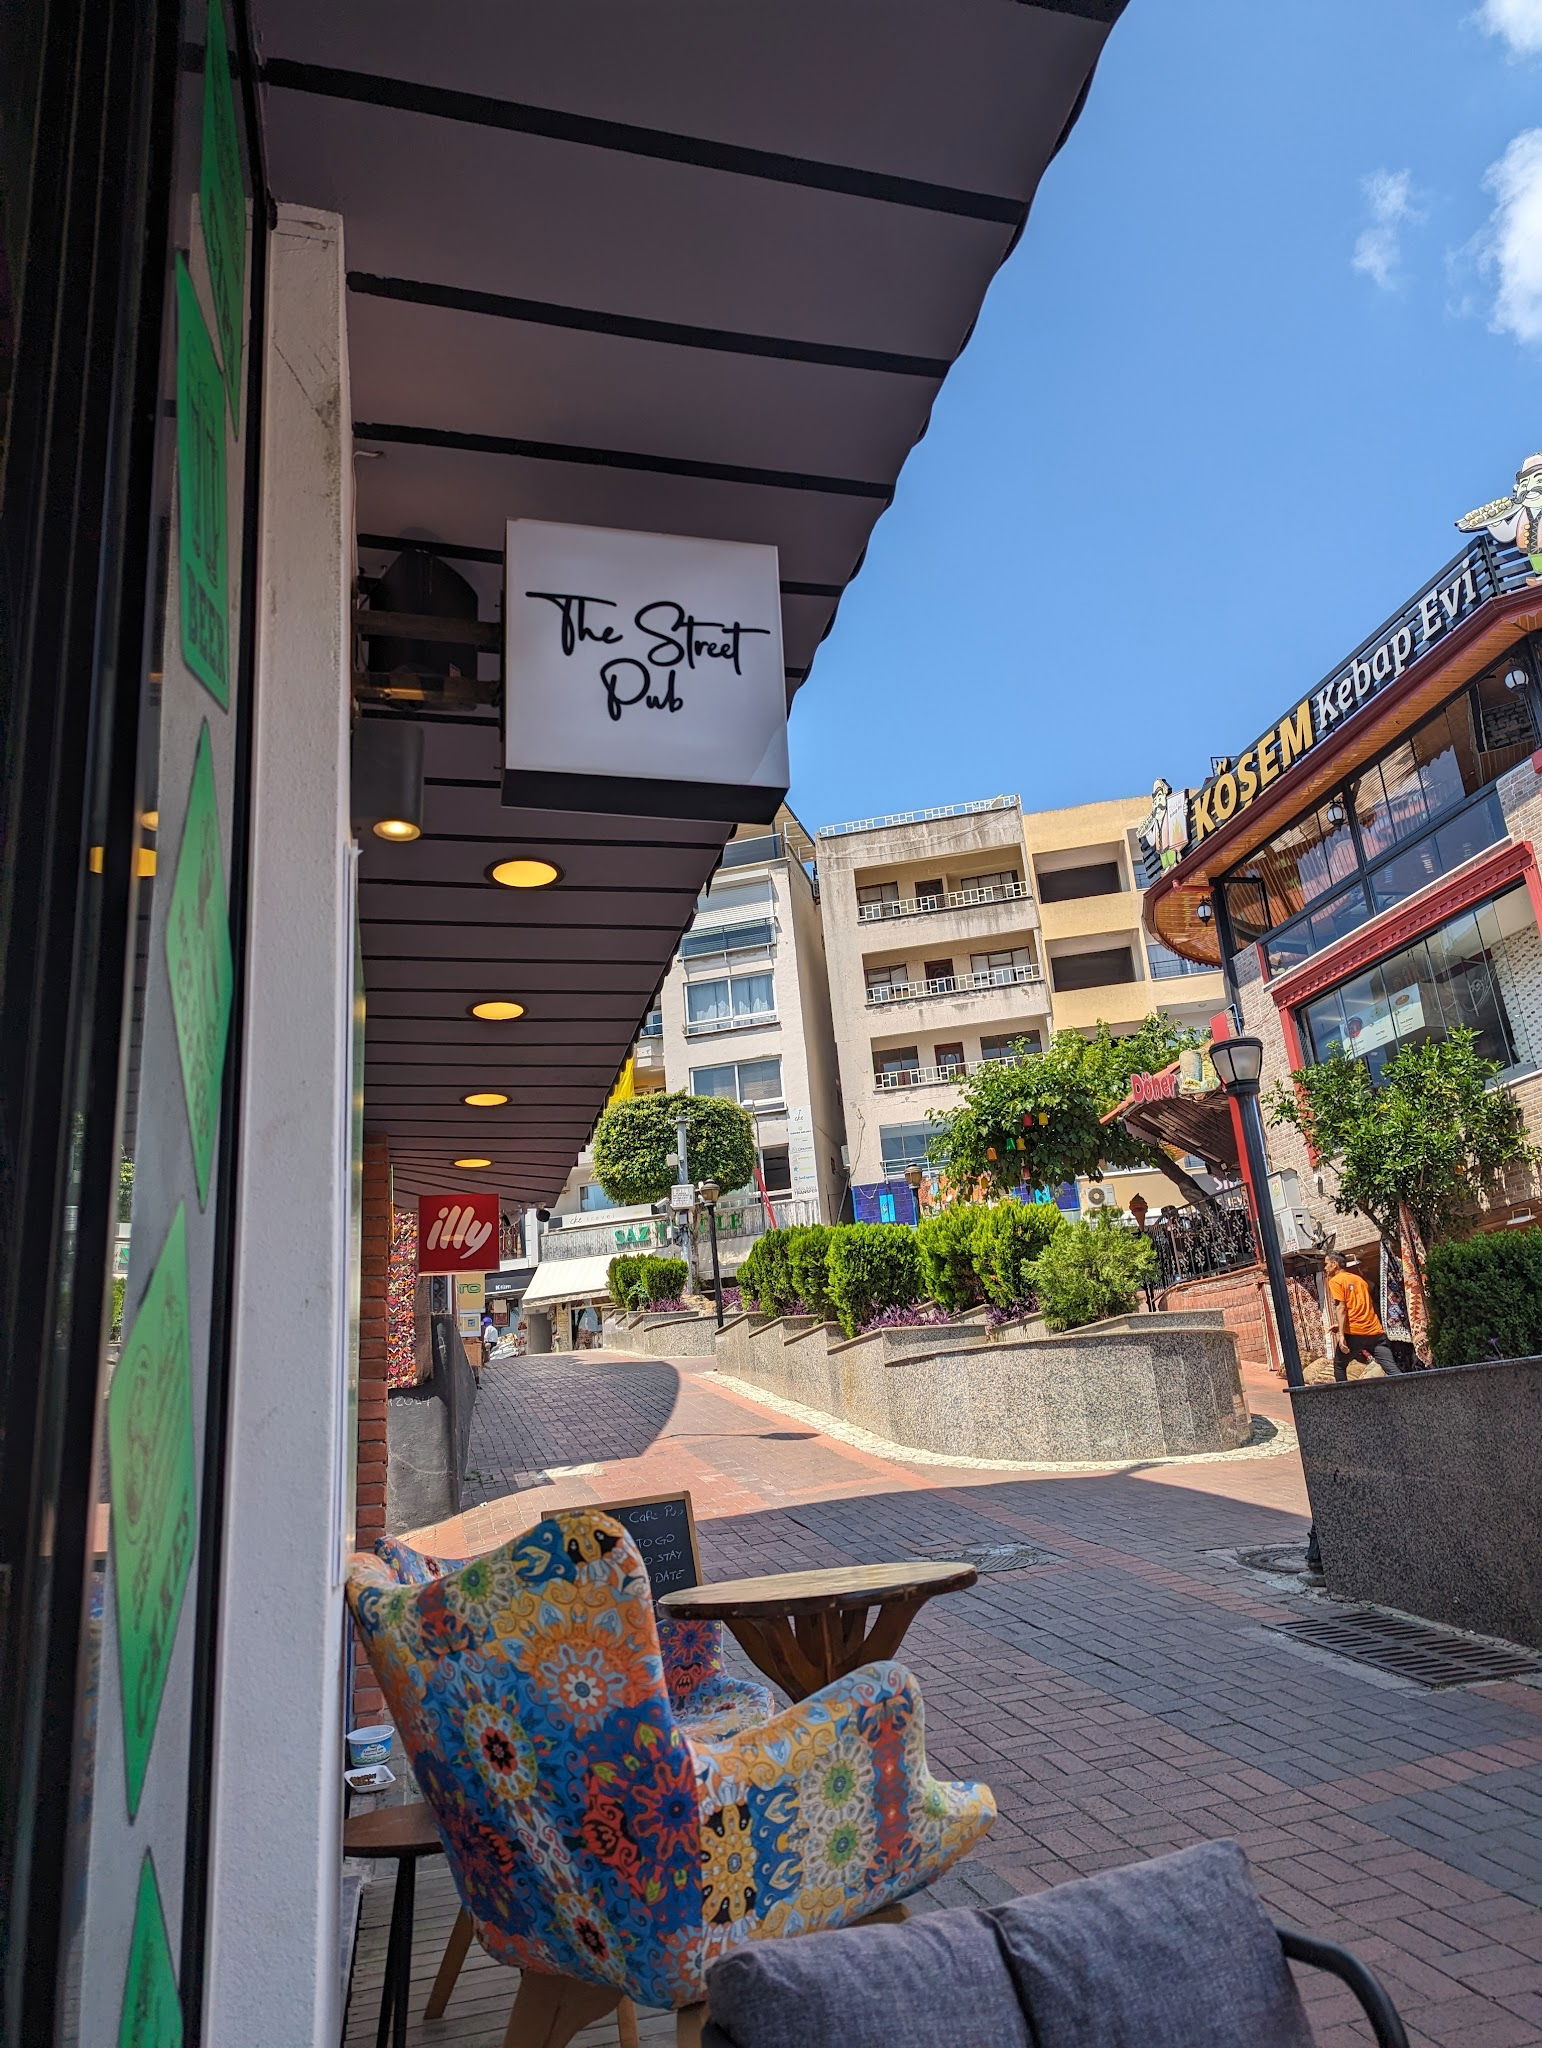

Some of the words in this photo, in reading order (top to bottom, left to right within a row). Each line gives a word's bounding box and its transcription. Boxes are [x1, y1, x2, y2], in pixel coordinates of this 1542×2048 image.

[186, 562, 227, 686] BEER
[525, 591, 623, 656] The
[635, 601, 771, 676] Street
[1316, 626, 1411, 730] Kebap
[1418, 558, 1477, 642] Evi
[600, 658, 684, 721] Pub
[1131, 1071, 1176, 1103] Döner
[427, 1205, 493, 1259] illy
[614, 1225, 650, 1245] SAZ
[655, 1533, 675, 1545] GO
[657, 1550, 682, 1563] STAY
[655, 1568, 685, 1583] DATE
